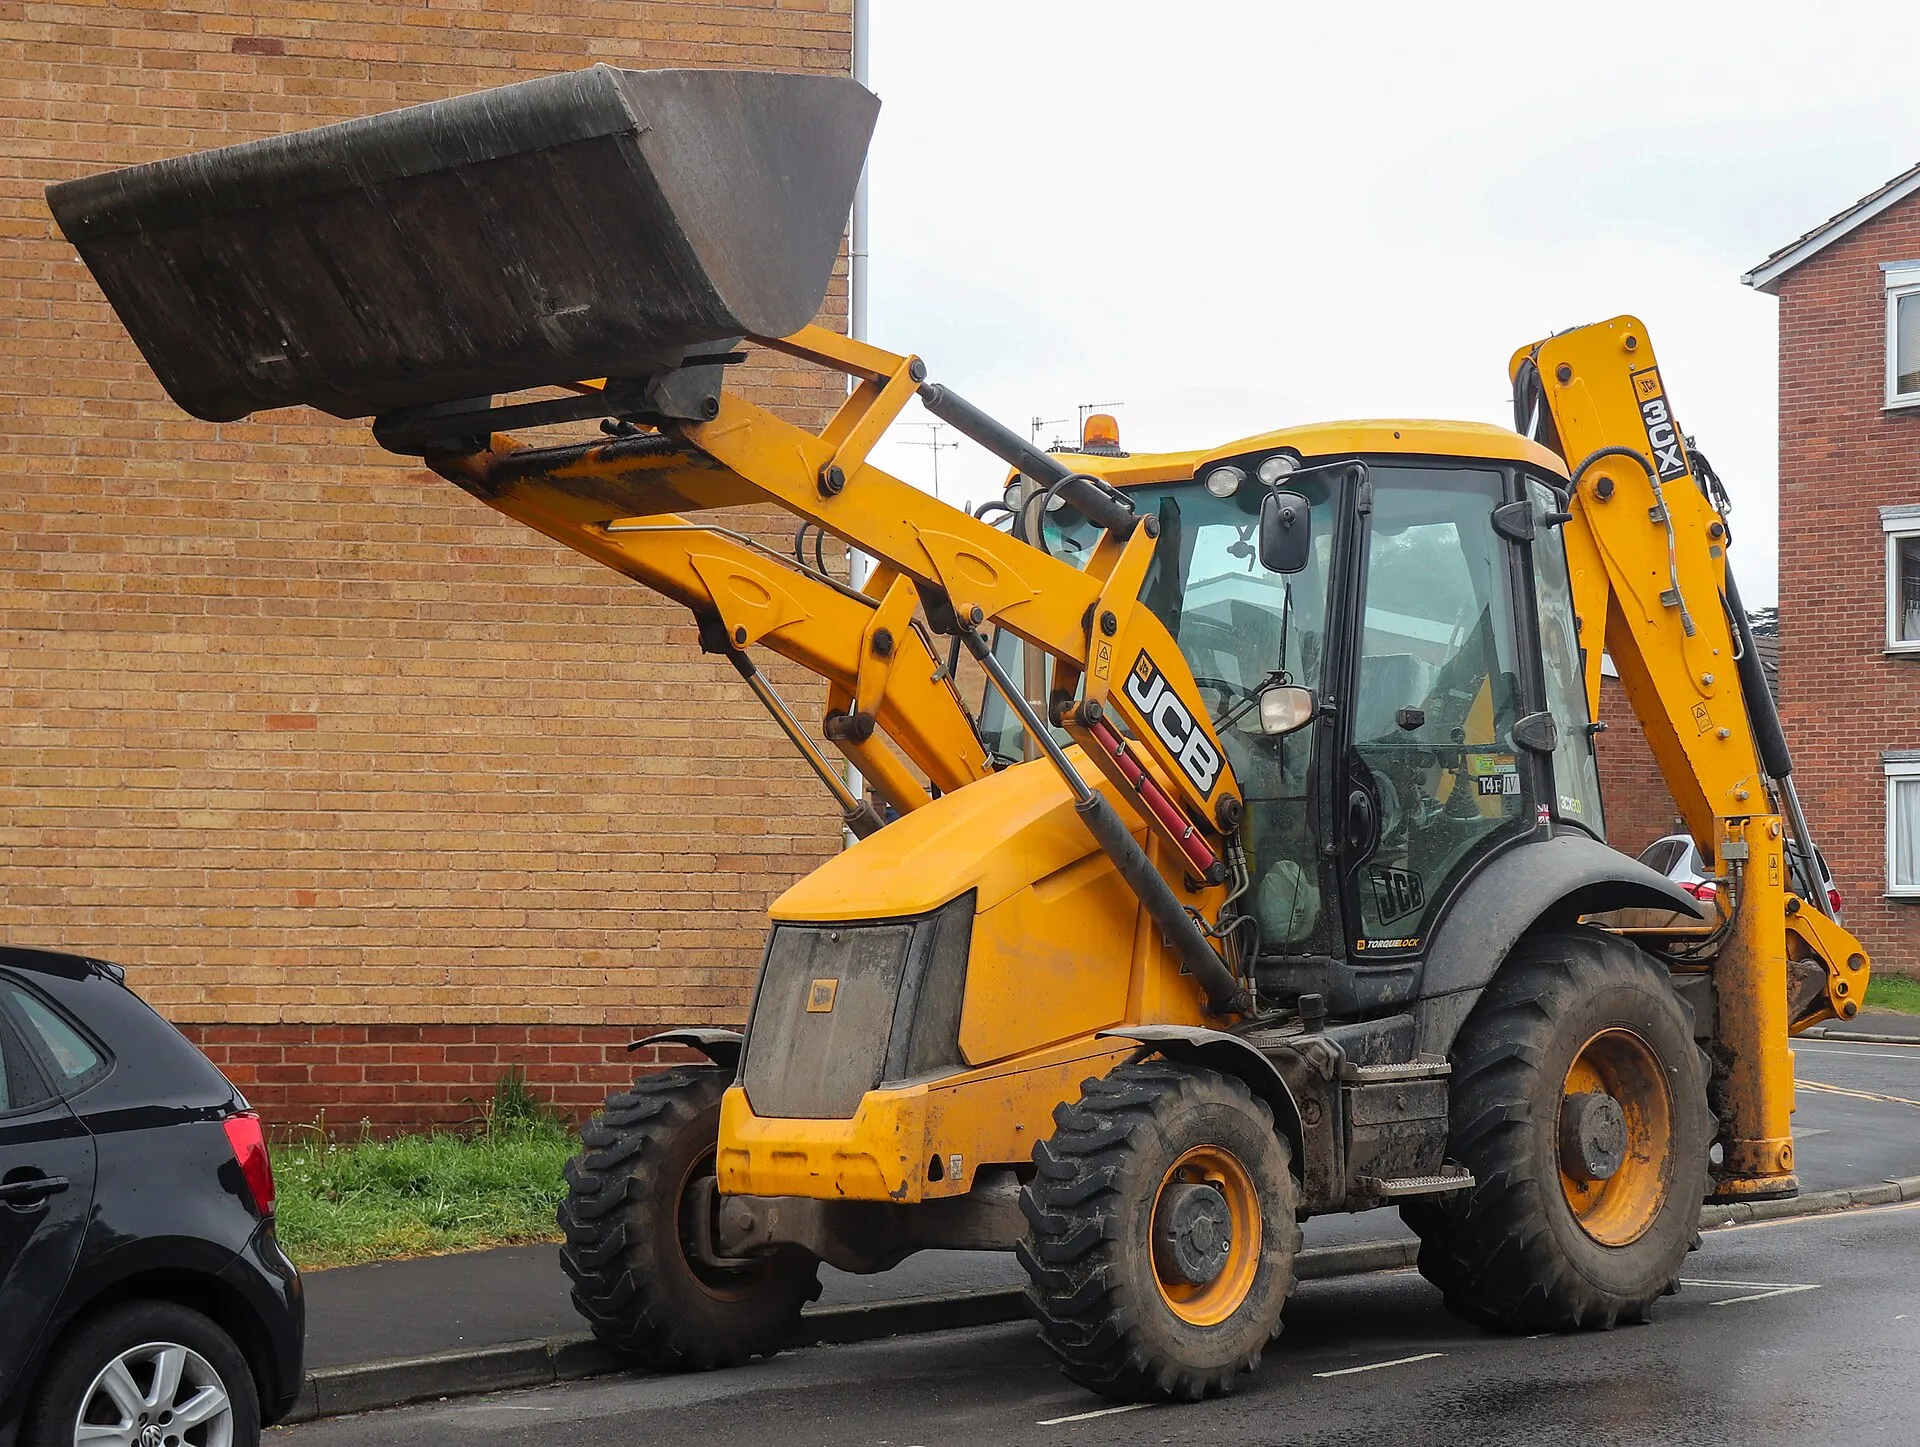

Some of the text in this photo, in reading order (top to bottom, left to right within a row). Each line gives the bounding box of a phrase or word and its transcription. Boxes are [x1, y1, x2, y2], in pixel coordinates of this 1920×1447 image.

[1641, 380, 1657, 393] JCB
[1642, 400, 1684, 473] 3CX
[1127, 672, 1220, 793] JCB
[1379, 871, 1421, 919] JCB
[1367, 939, 1420, 949] TORQUELOCK
